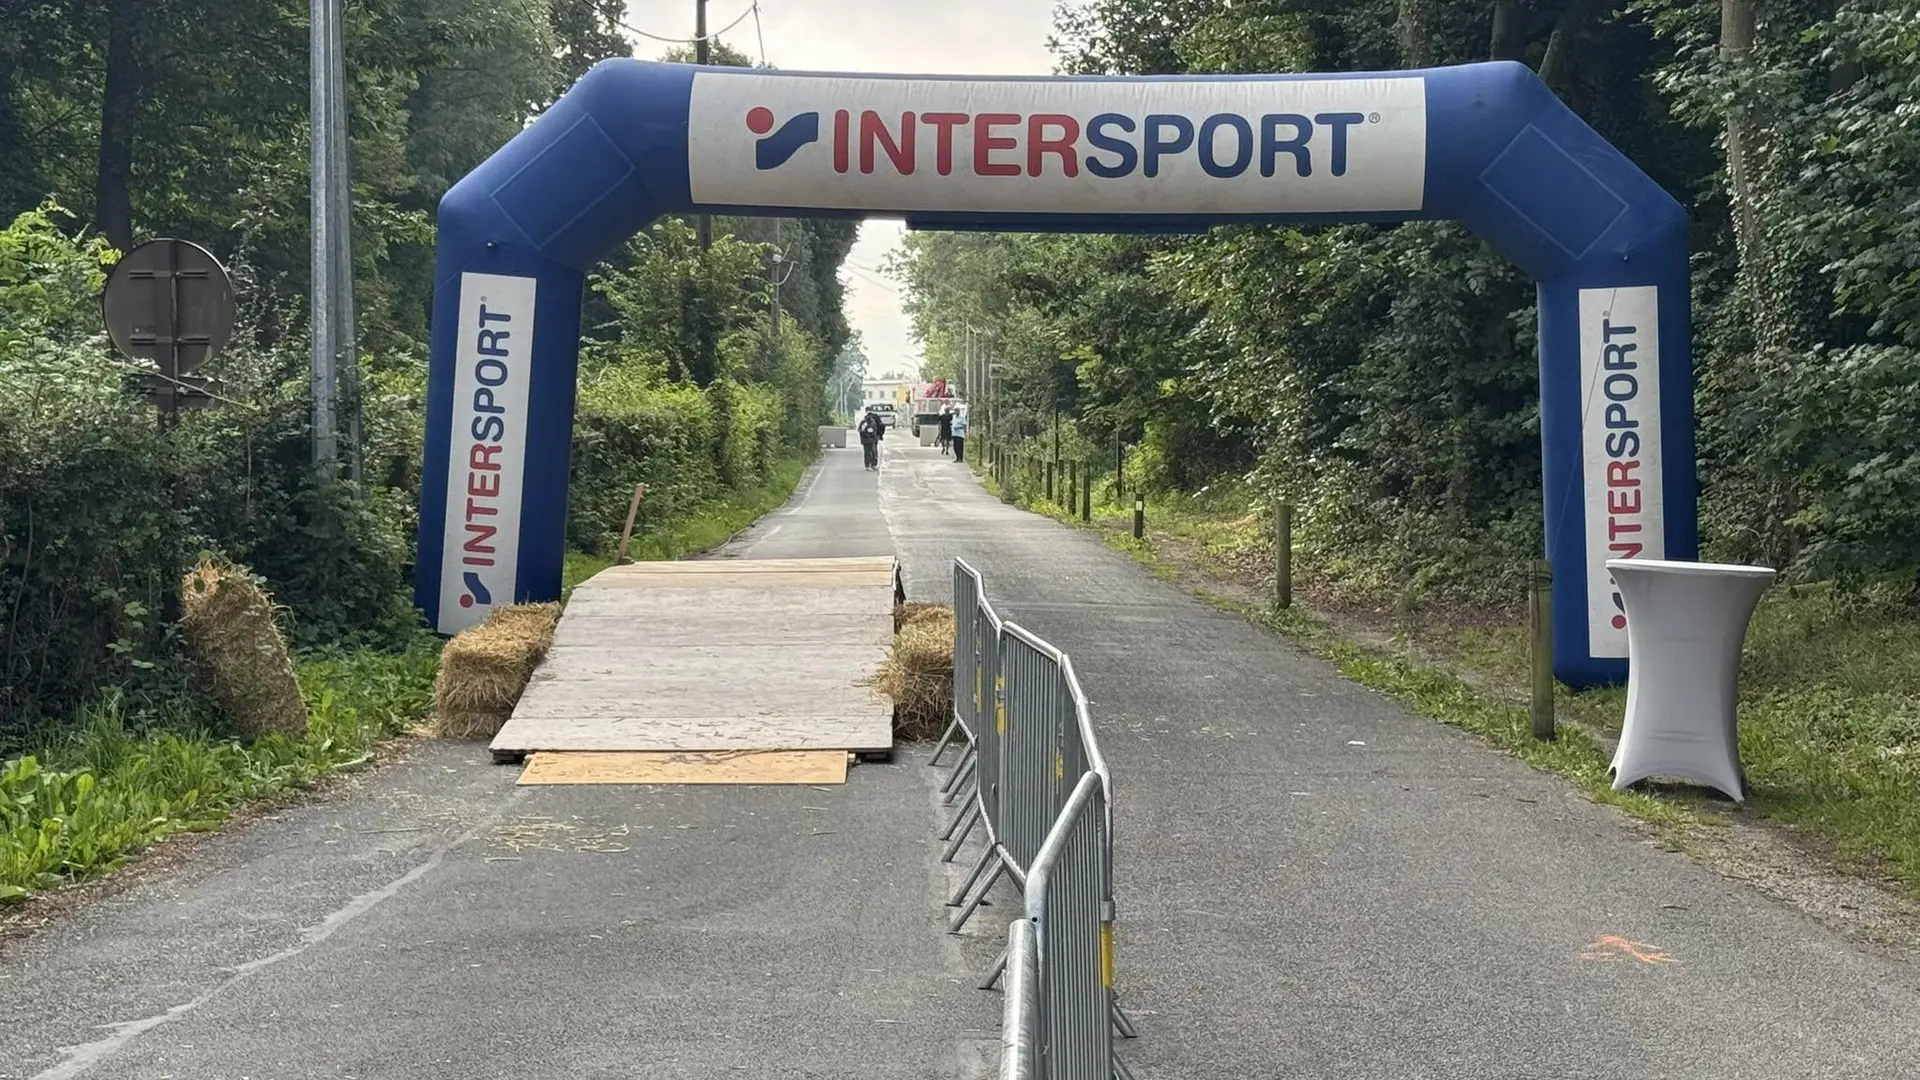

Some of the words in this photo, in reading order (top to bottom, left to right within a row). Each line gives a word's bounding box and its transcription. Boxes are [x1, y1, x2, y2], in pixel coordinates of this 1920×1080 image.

[833, 109, 1364, 178] INTERSPORT
[462, 303, 512, 567] INTERSPORT
[1602, 318, 1642, 585] NTERSPORT
